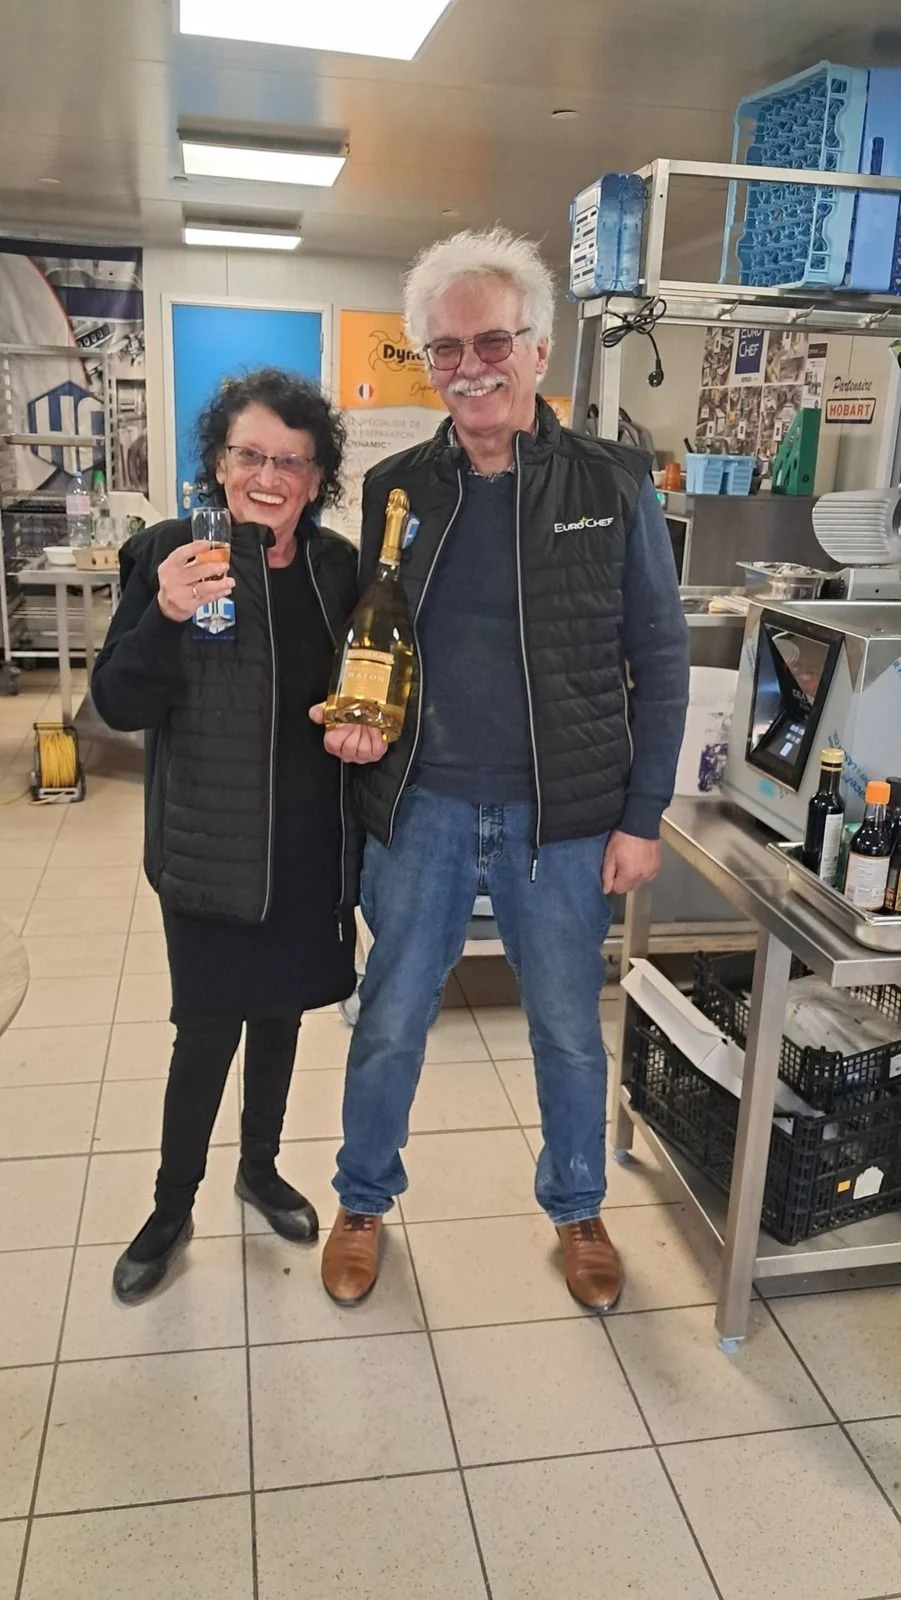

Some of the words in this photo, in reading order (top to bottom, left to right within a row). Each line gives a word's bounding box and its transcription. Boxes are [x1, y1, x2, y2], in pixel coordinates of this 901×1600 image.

[739, 341, 760, 357] CHEF
[832, 376, 873, 393] Partenaire
[829, 404, 871, 417] HOBART
